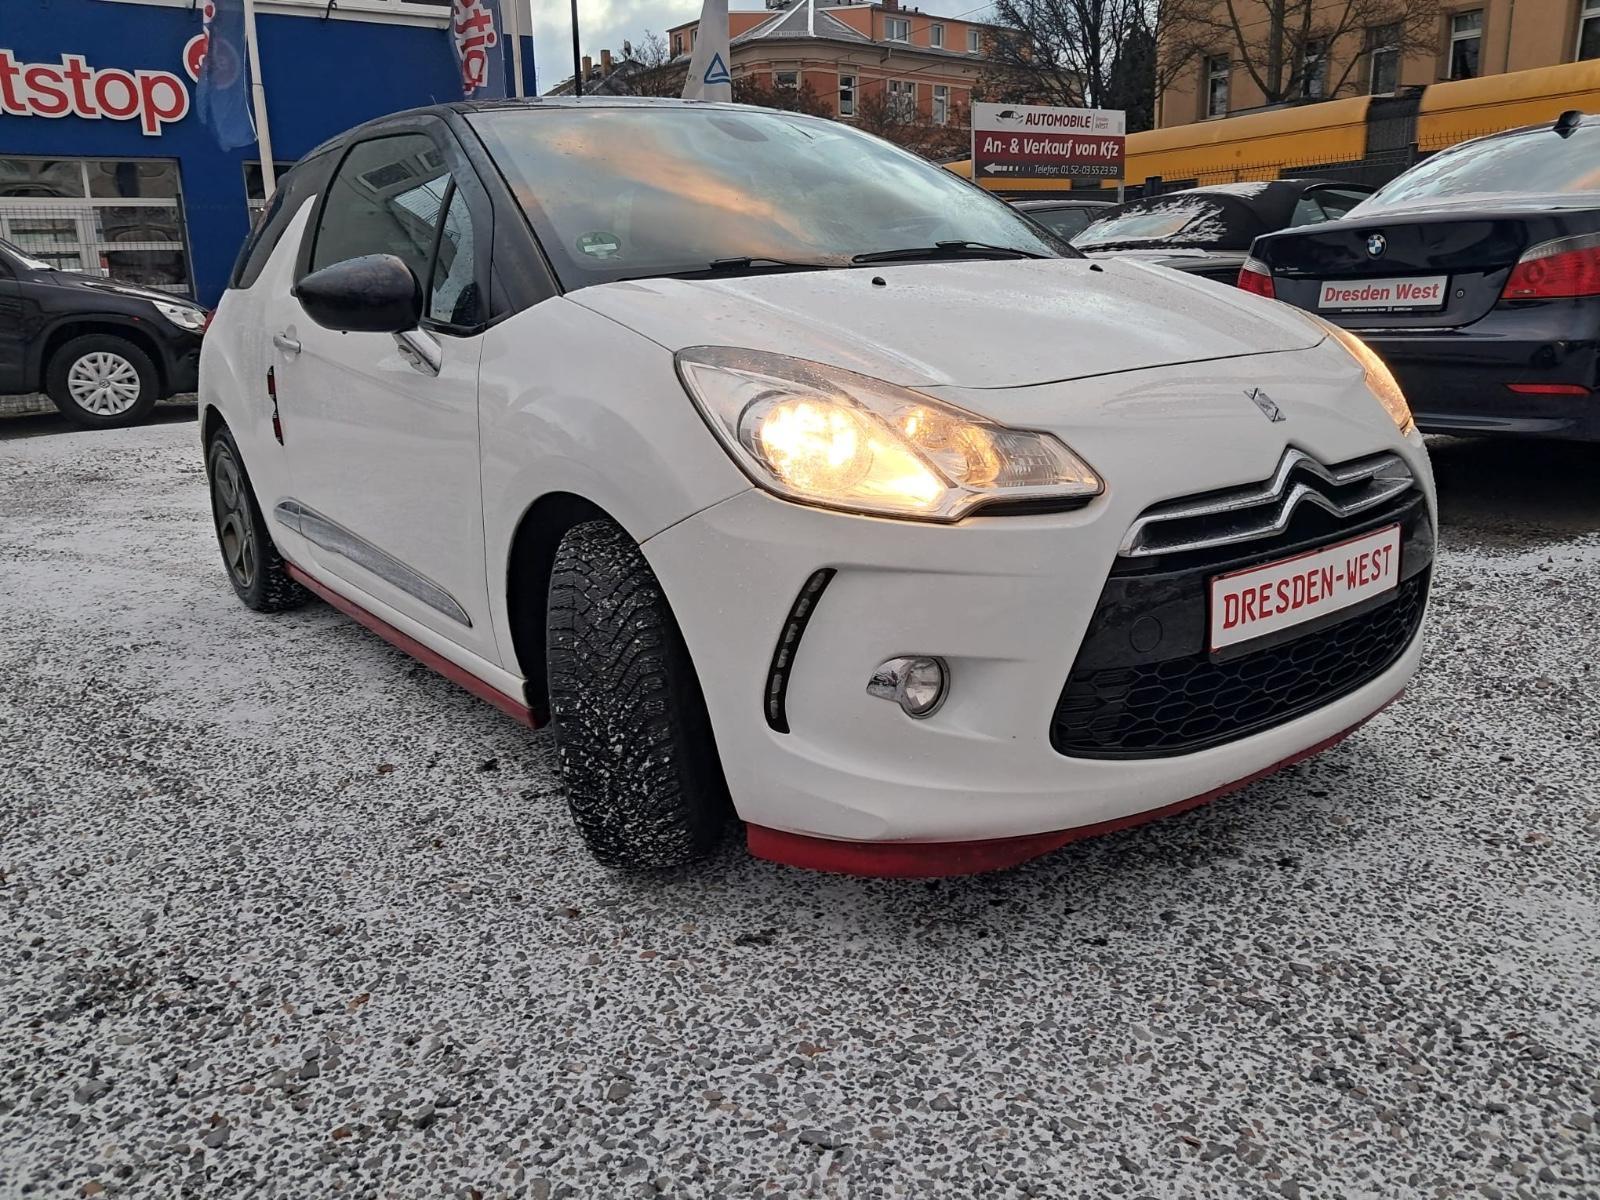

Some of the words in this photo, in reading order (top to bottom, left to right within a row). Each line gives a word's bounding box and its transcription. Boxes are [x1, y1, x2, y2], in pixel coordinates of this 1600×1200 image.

[1025, 112, 1092, 129] AUTOMOBILE
[983, 136, 1006, 153] An-
[1010, 137, 1019, 154] &
[1024, 138, 1073, 158] Verkauf
[1075, 144, 1097, 157] von
[1100, 141, 1120, 159] Kfz
[1034, 164, 1059, 176] Telefon:
[1325, 284, 1390, 303] Dresden
[1396, 283, 1440, 300] West
[1223, 544, 1393, 629] DRESDEN-WEST
